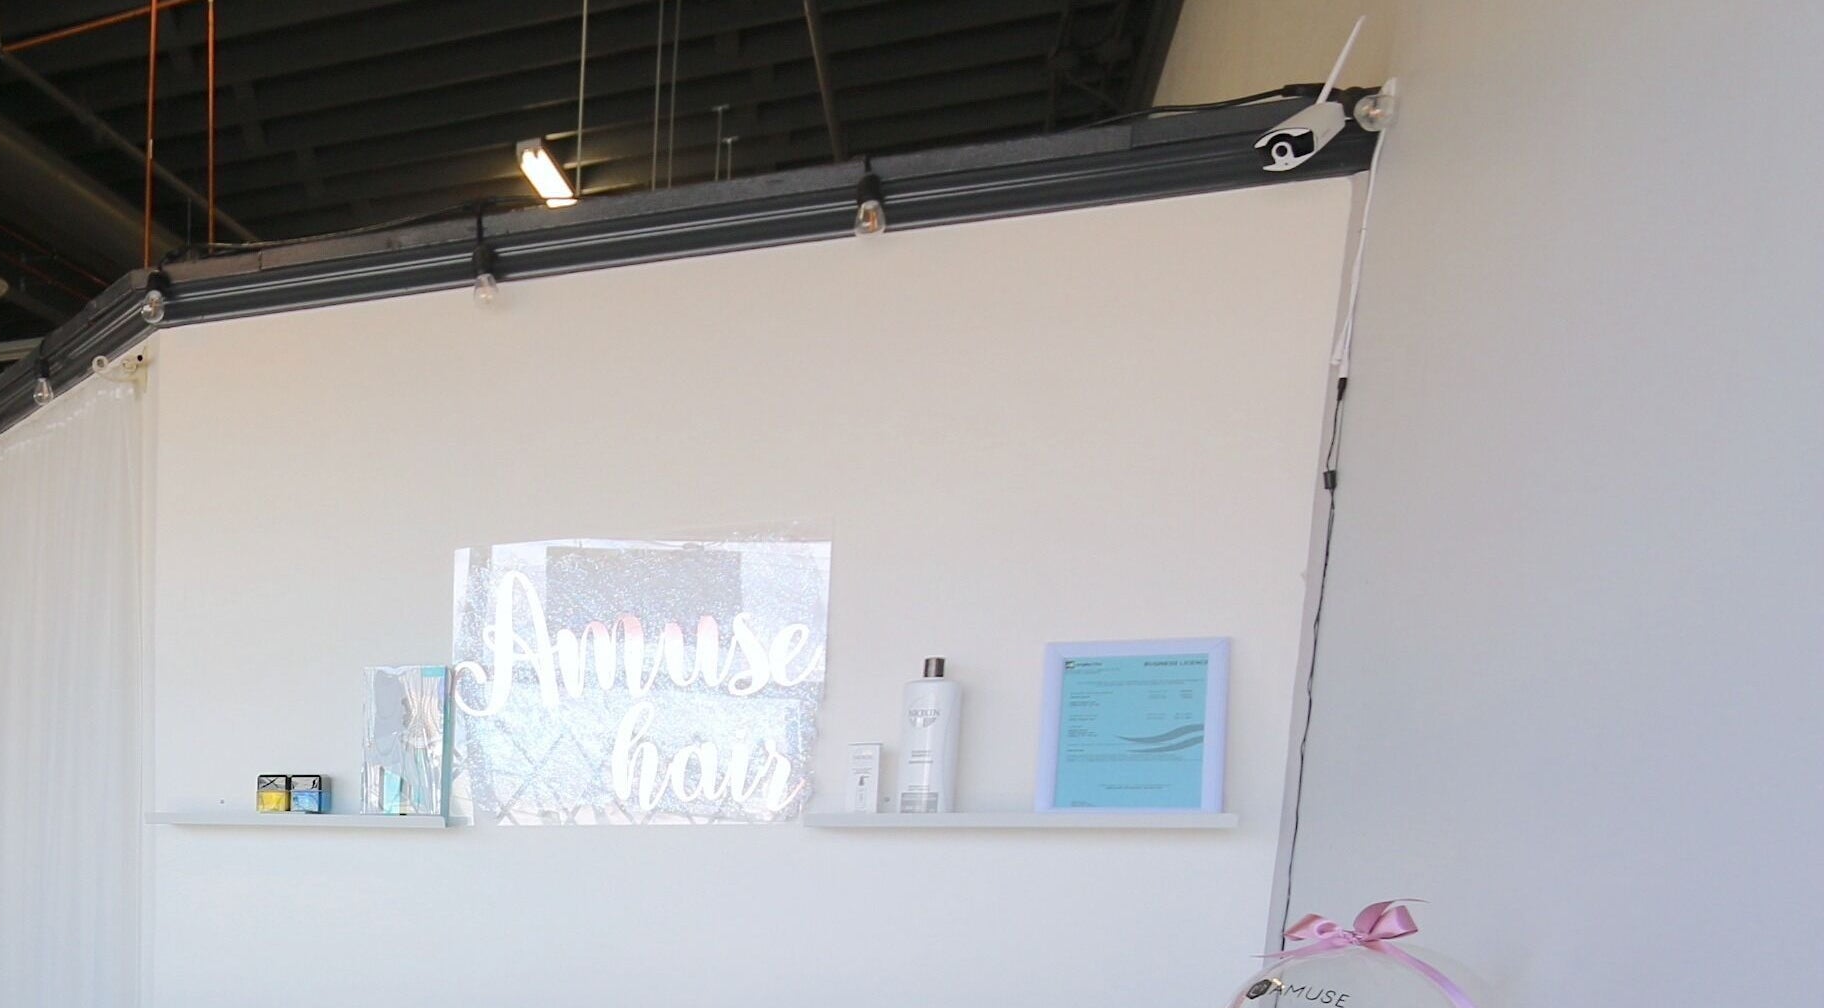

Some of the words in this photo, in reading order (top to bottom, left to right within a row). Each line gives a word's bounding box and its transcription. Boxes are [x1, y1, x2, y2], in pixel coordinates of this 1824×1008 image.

[454, 570, 826, 716] Amuse
[611, 701, 805, 811] hair
[1269, 984, 1350, 1008] AMUSE
